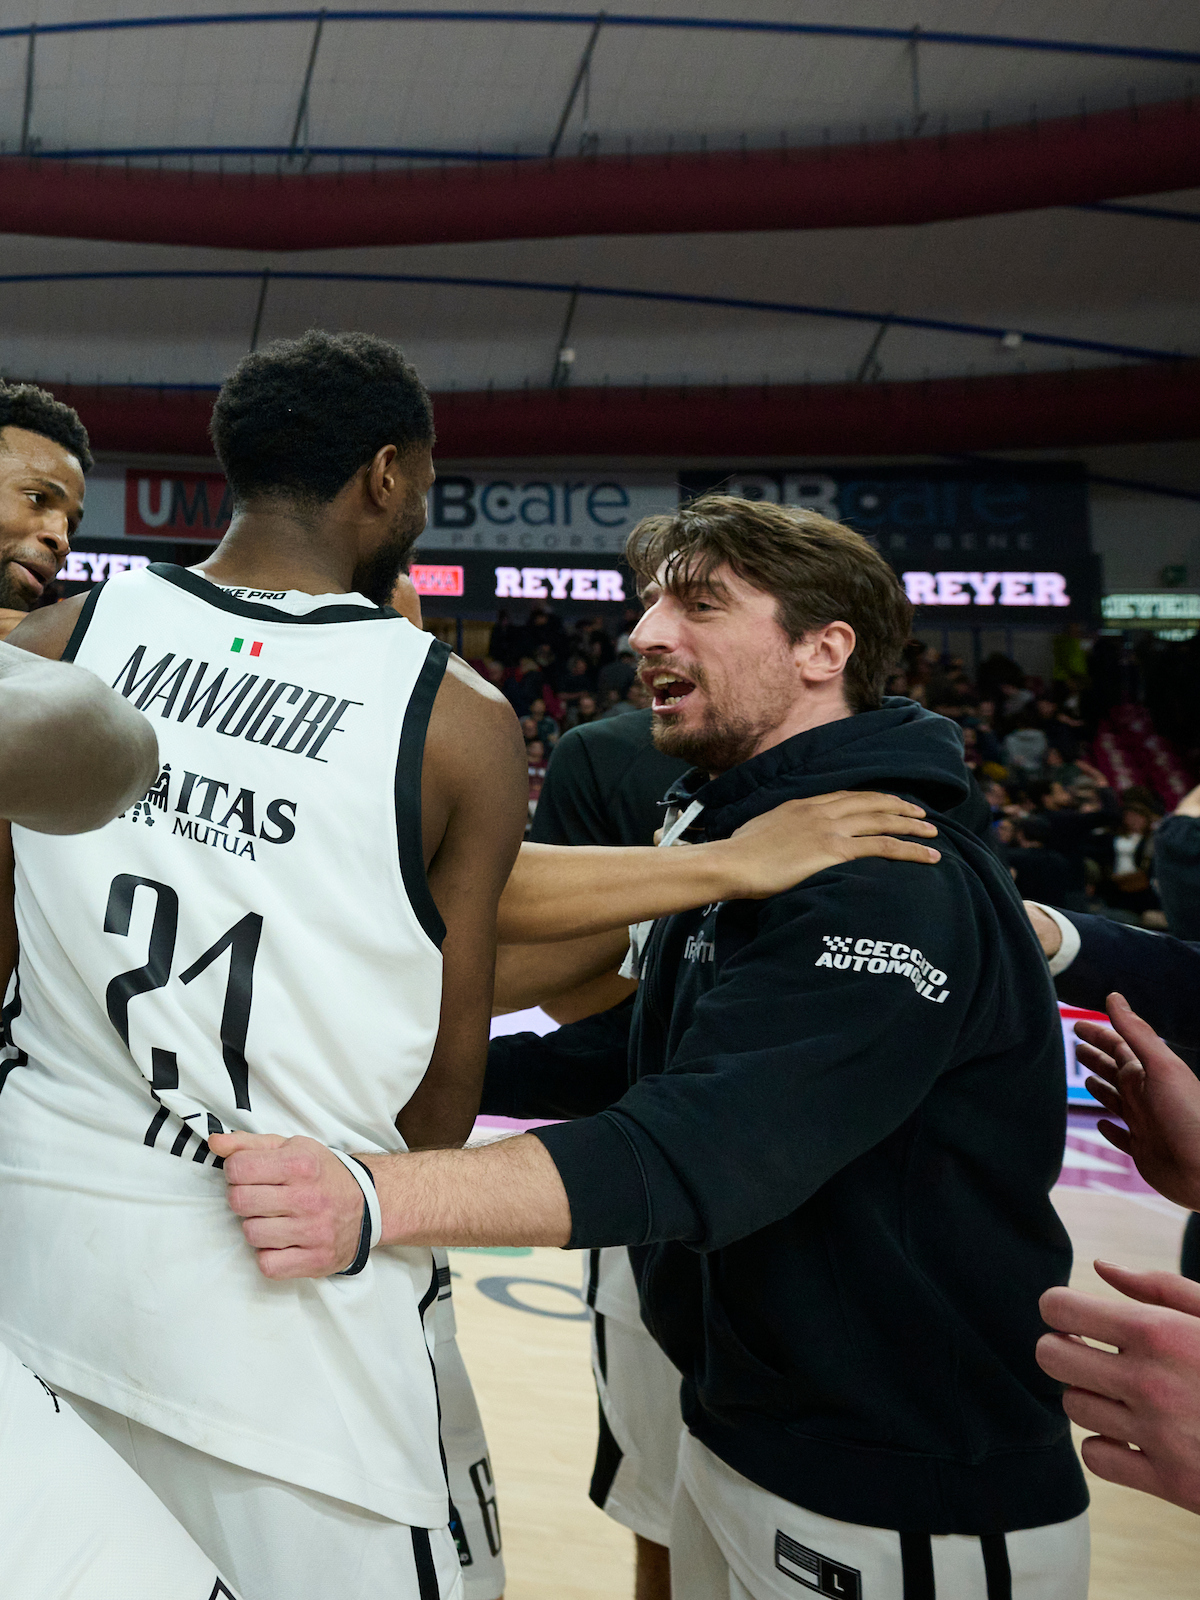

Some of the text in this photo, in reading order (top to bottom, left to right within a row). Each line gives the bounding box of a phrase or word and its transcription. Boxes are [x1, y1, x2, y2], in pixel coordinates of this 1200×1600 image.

[54, 550, 151, 582] EYER
[495, 566, 626, 602] REYER
[247, 590, 287, 601] PRO
[902, 571, 1071, 607] REYER
[111, 644, 364, 763] MAWUGBE
[174, 770, 298, 845] ITAS
[171, 816, 257, 862] MUTUA
[102, 872, 264, 1112] 21
